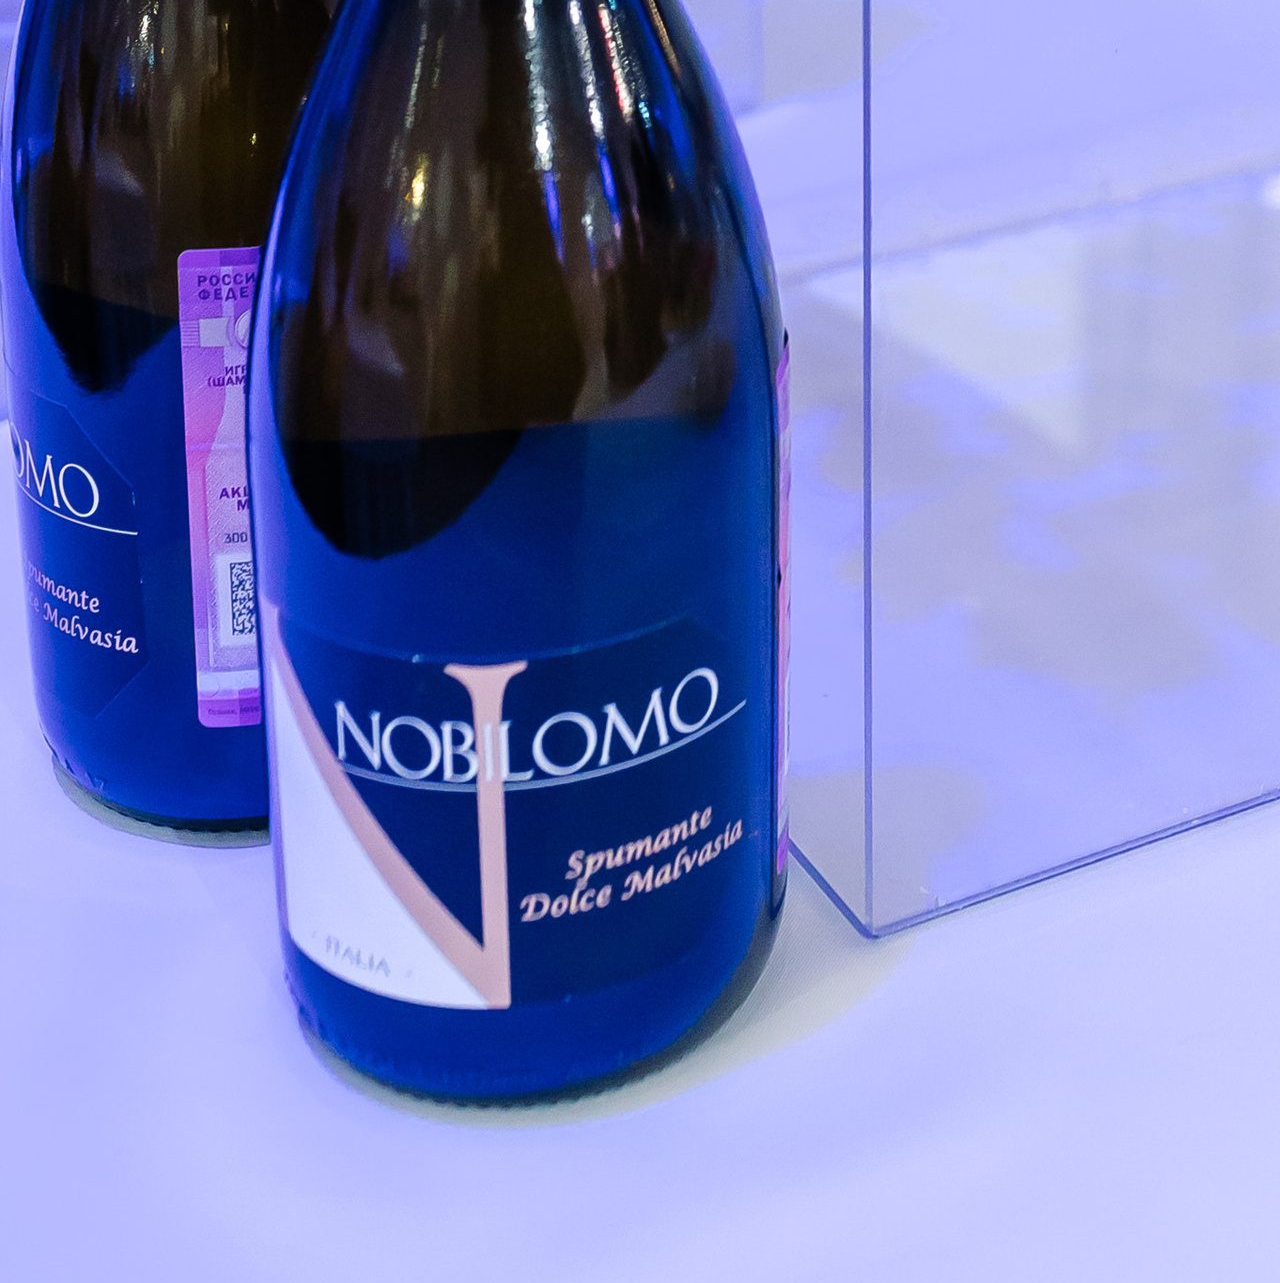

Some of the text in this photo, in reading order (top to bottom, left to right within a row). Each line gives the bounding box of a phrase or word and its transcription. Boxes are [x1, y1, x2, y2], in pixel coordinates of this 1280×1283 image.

[198, 286, 249, 302] ФЕДЕ
[334, 667, 719, 783] NOBILOMO
[519, 819, 743, 922] Dolce Malvasia
[565, 805, 713, 888] Spumante
